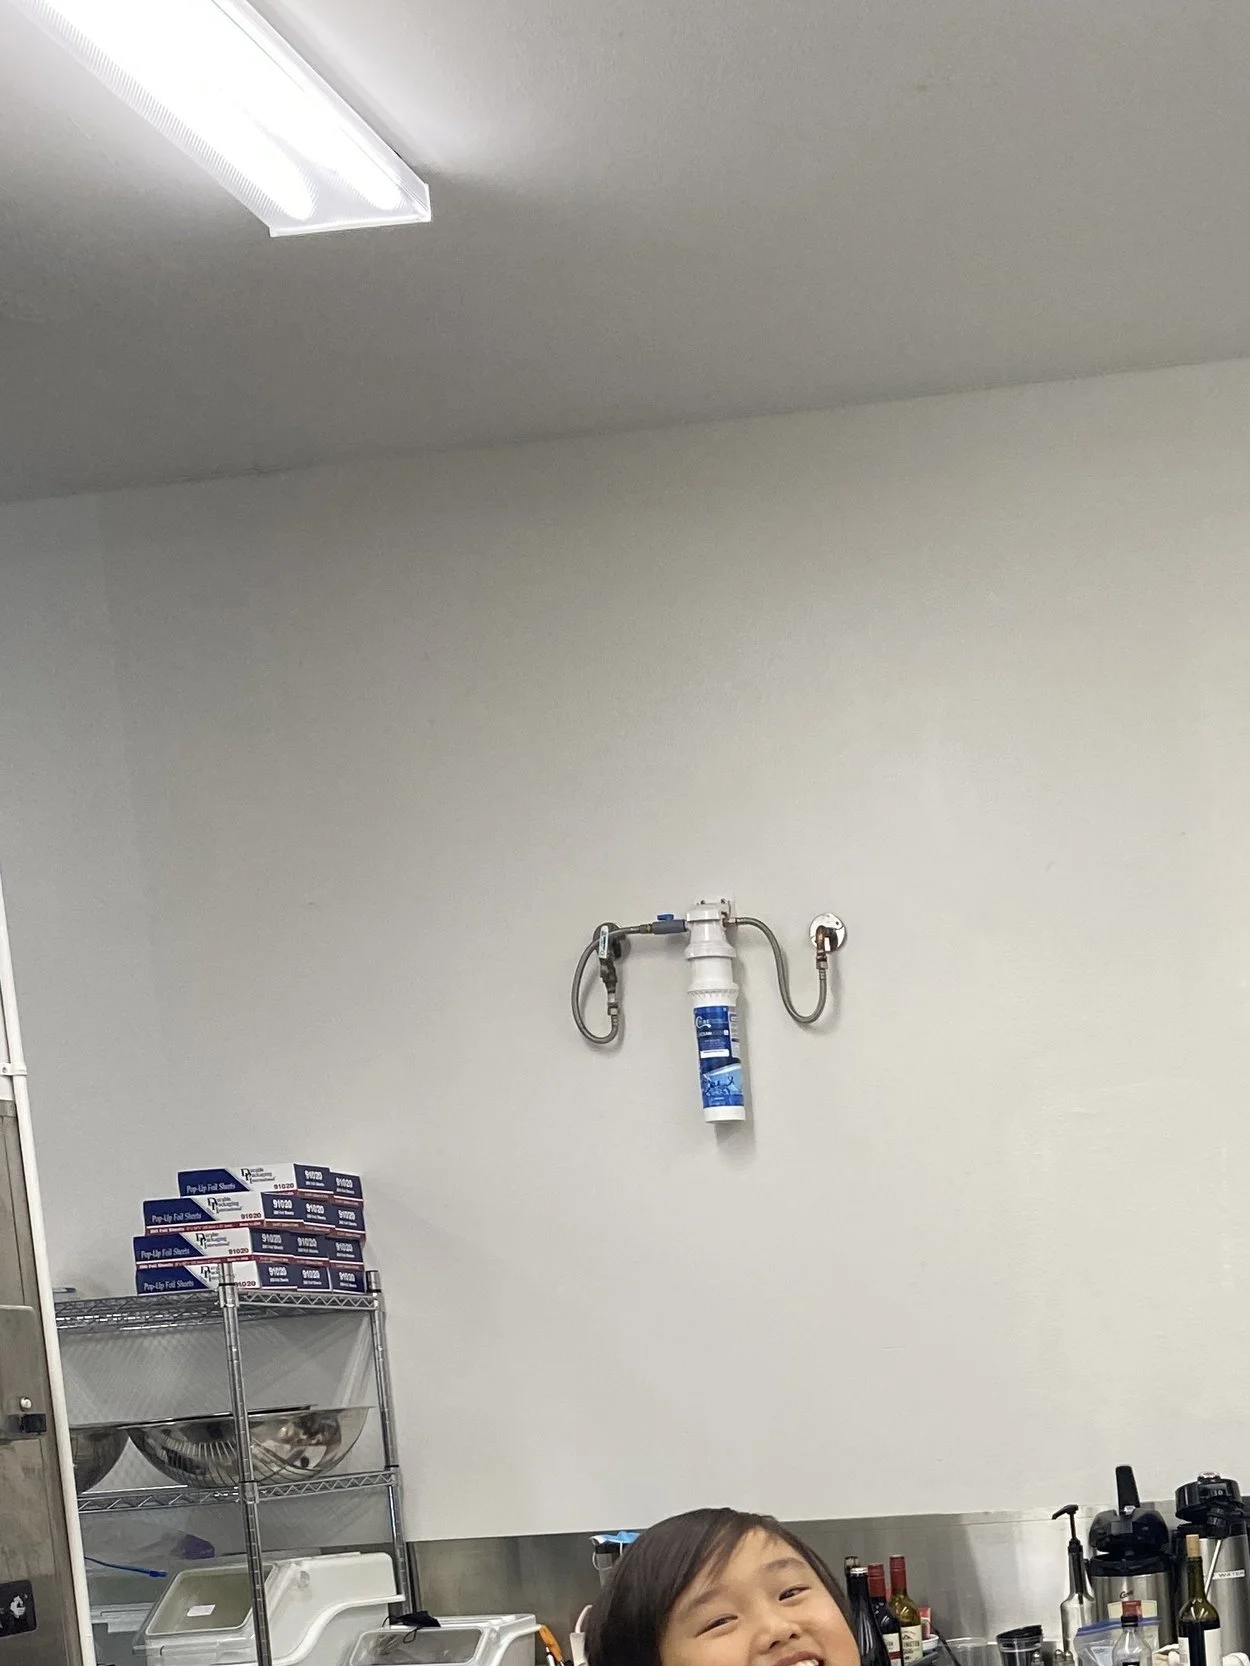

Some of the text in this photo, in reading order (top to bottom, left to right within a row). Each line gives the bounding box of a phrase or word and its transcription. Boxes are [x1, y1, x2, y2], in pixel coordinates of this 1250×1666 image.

[186, 1184, 206, 1194] Pop-Up
[208, 1183, 218, 1191] Foil
[151, 1214, 173, 1223] Pop-Up
[173, 1213, 184, 1221] Foil
[141, 1249, 161, 1259] Pop-Up
[162, 1249, 172, 1257] Foil
[143, 1282, 165, 1291] Pop-Up
[166, 1281, 176, 1289] Foil
